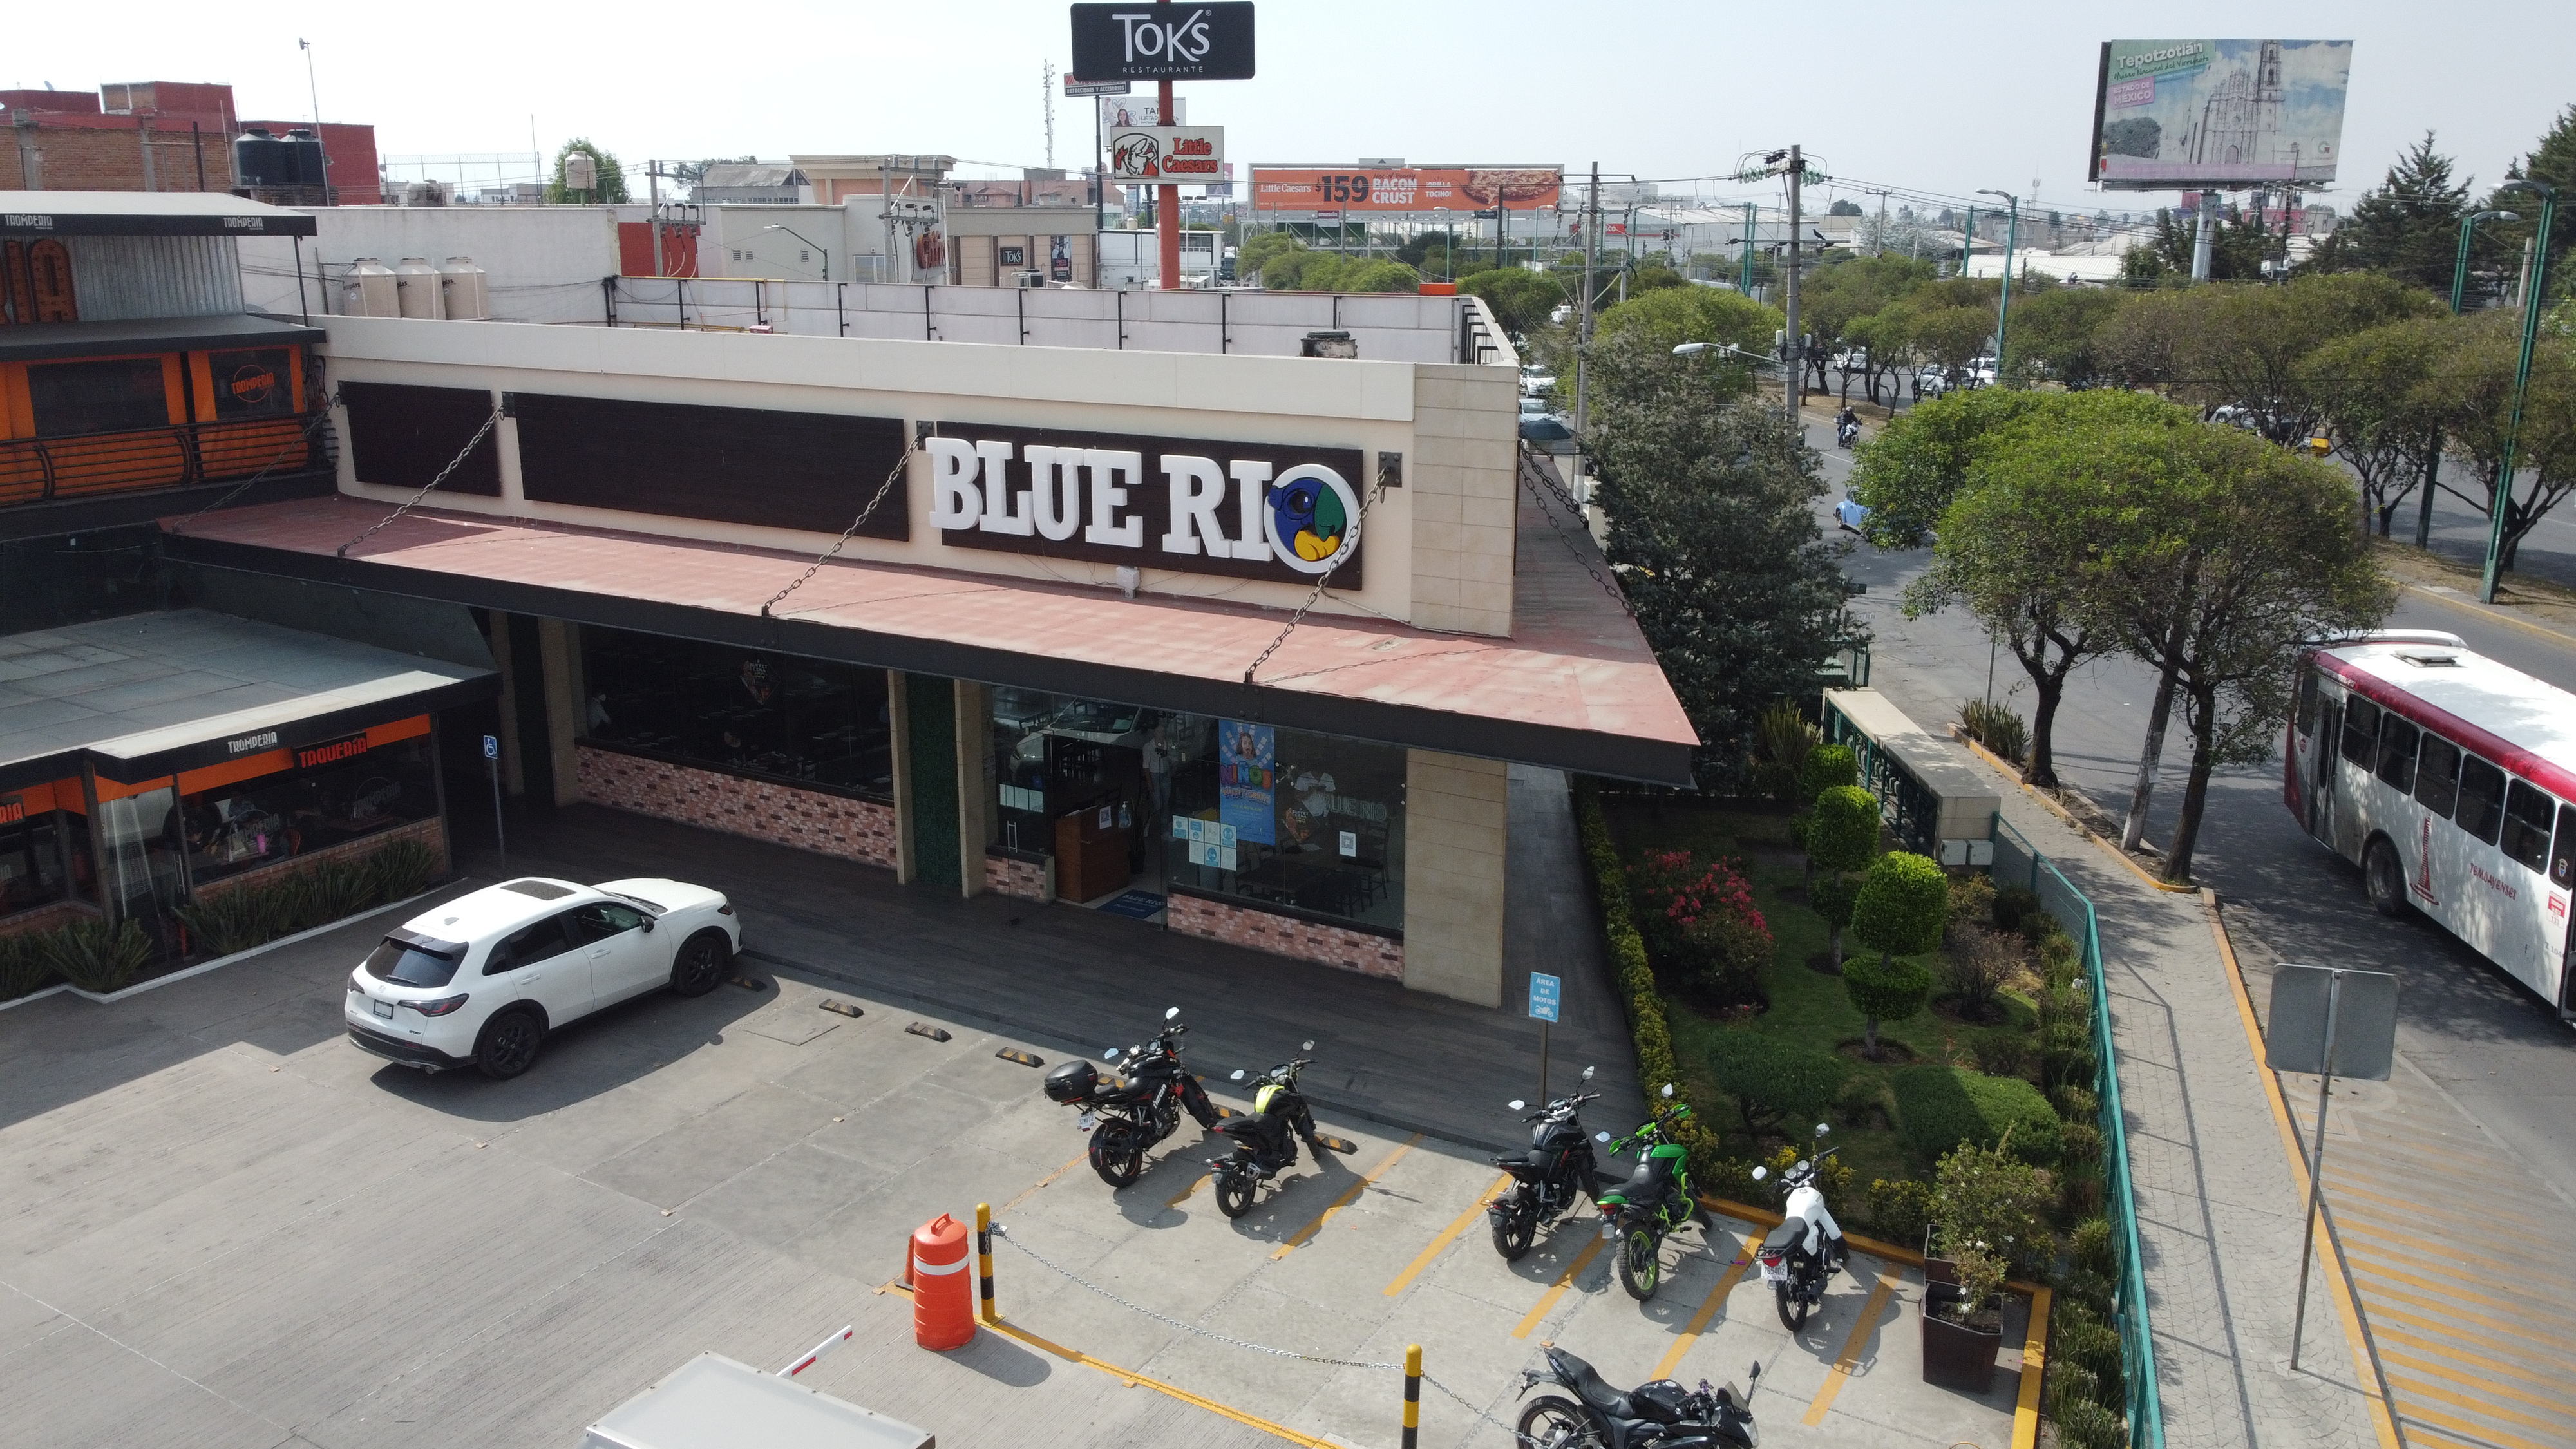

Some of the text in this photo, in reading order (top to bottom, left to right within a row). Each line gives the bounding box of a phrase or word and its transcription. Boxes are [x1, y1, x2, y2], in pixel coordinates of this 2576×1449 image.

[2117, 41, 2203, 69] Tepotzotlán
[2114, 72, 2136, 80] Museo
[2137, 64, 2163, 75] Nacional
[2165, 61, 2175, 70] del
[2113, 83, 2141, 94] ESTADO
[1173, 137, 1212, 155] Little
[1162, 155, 1218, 173] Caesars
[1282, 184, 1311, 192] Caesars
[1373, 178, 1417, 191] BACON
[1372, 191, 1415, 204] CRUST
[925, 437, 1363, 574] BLUE RIO
[299, 737, 367, 768] TAQUERÍA
[1323, 795, 1357, 816] BLUE
[2470, 863, 2517, 900] TEMOAYENSES
[1536, 976, 1555, 987] ÁREA
[1533, 995, 1556, 1005] MOTOS
